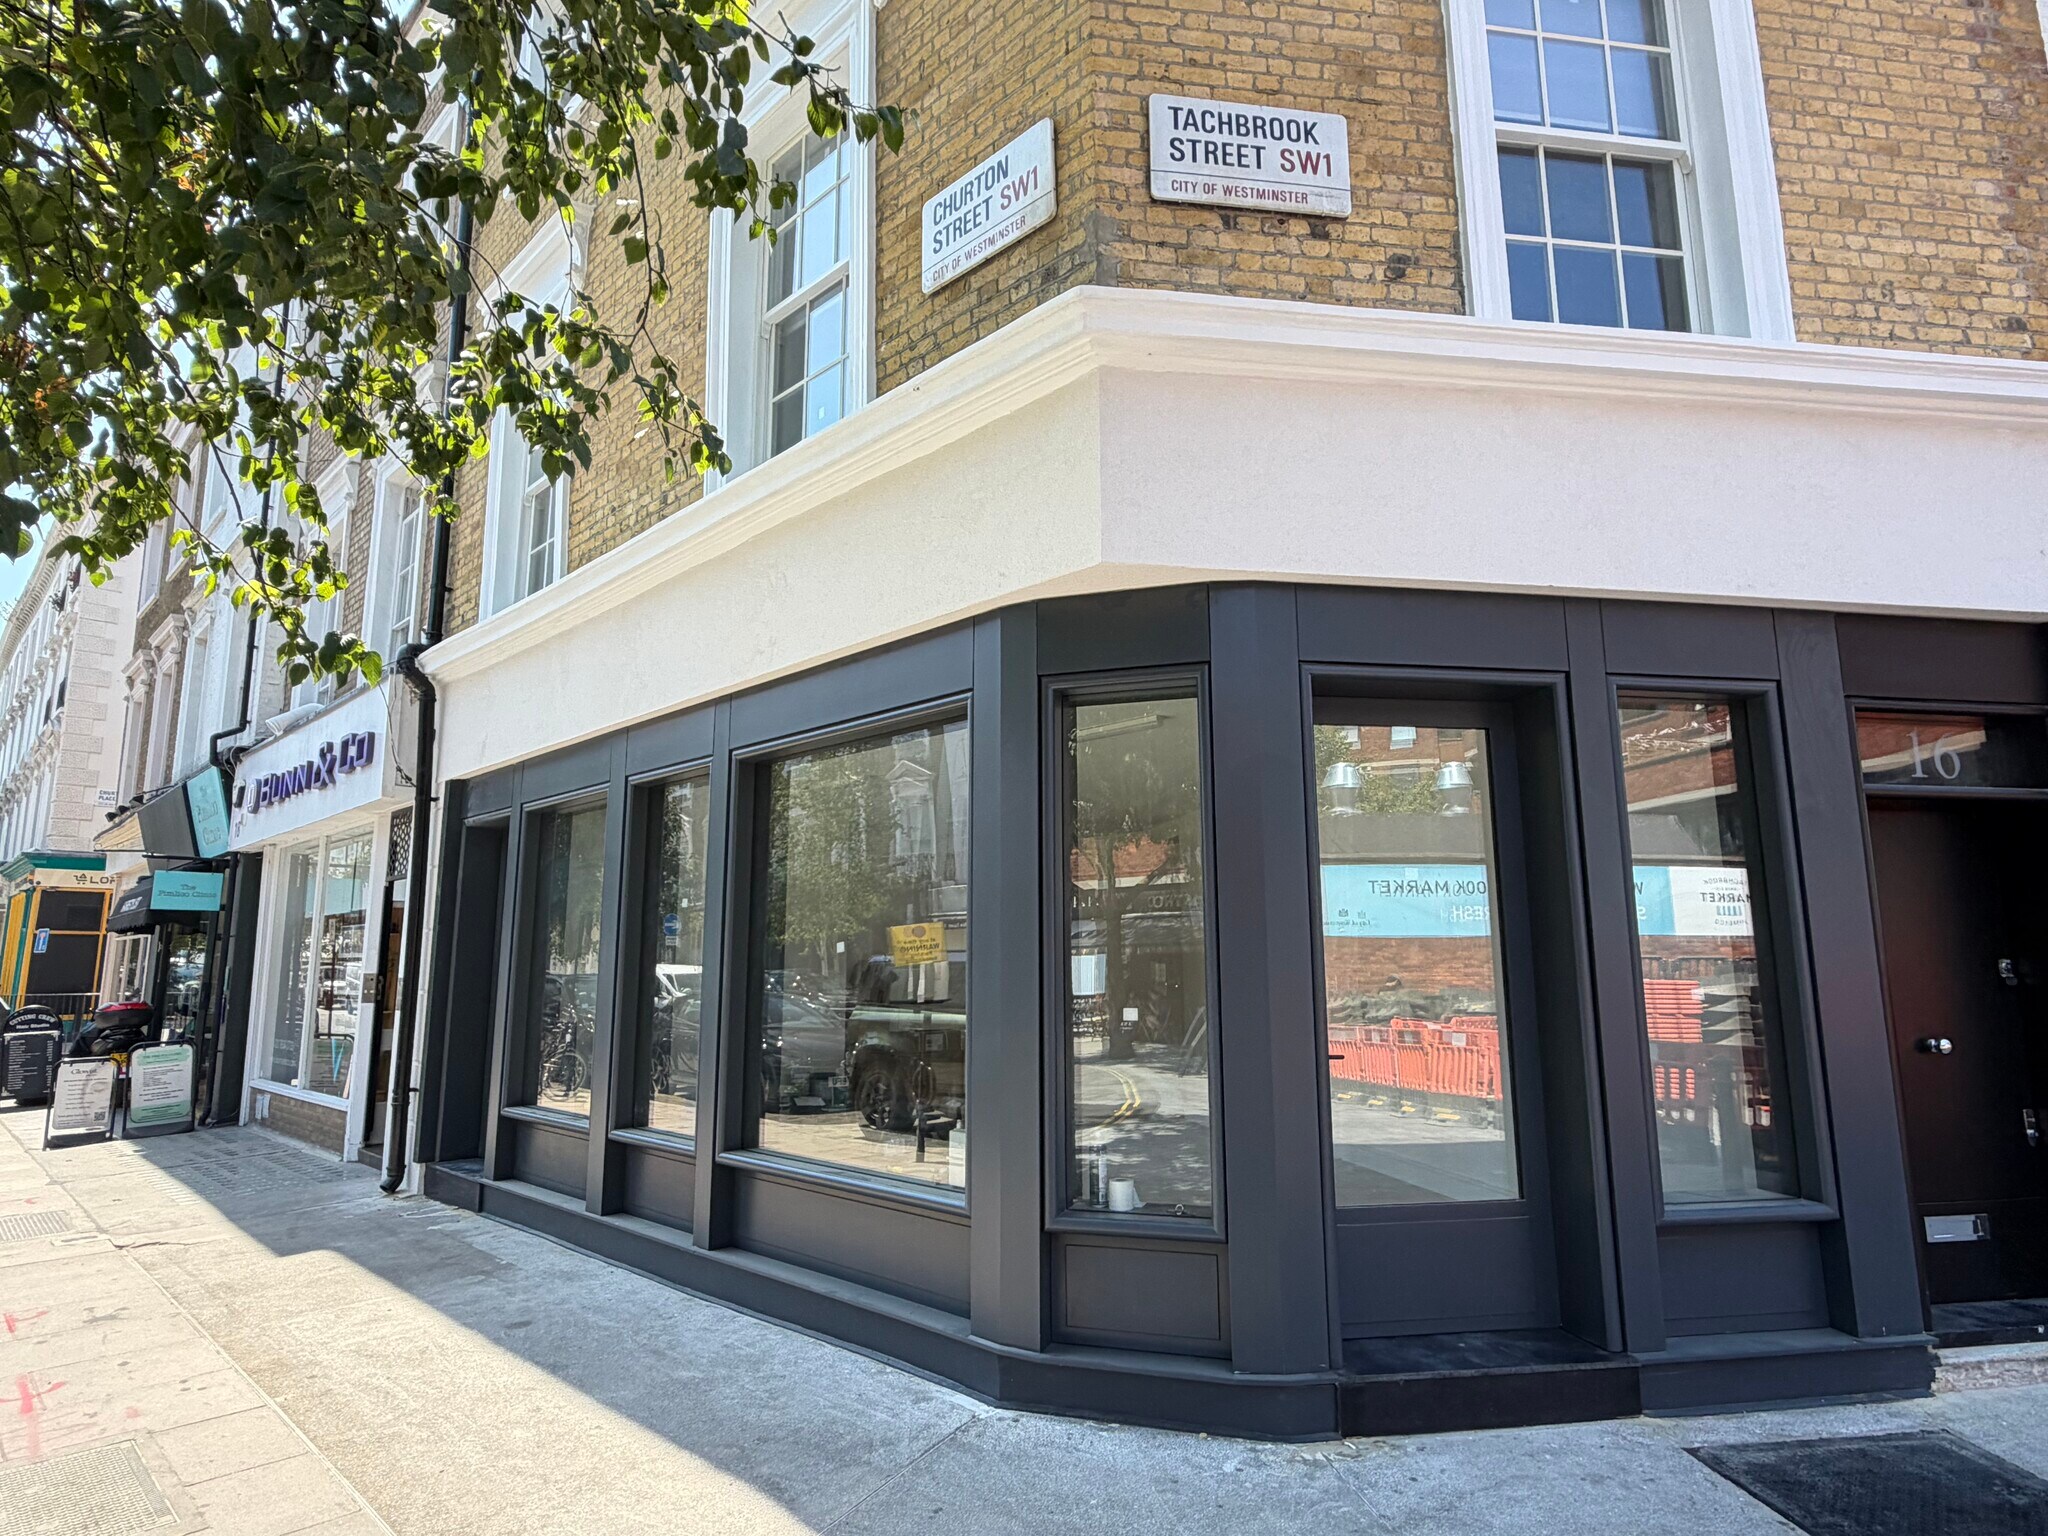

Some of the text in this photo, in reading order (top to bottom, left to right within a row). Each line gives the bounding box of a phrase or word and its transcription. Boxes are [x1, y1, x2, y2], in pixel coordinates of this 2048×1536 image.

[1167, 105, 1320, 146] TACHBROOK
[1169, 137, 1332, 177] STREET SW1
[932, 165, 1038, 255] STREET SW1
[933, 154, 1009, 226] CHURTON
[1171, 179, 1309, 205] CITY OF WESTMINSTER
[933, 215, 1026, 282] CITY OF WESTMINSTER
[338, 731, 376, 774] CO
[1905, 726, 1961, 780] 16
